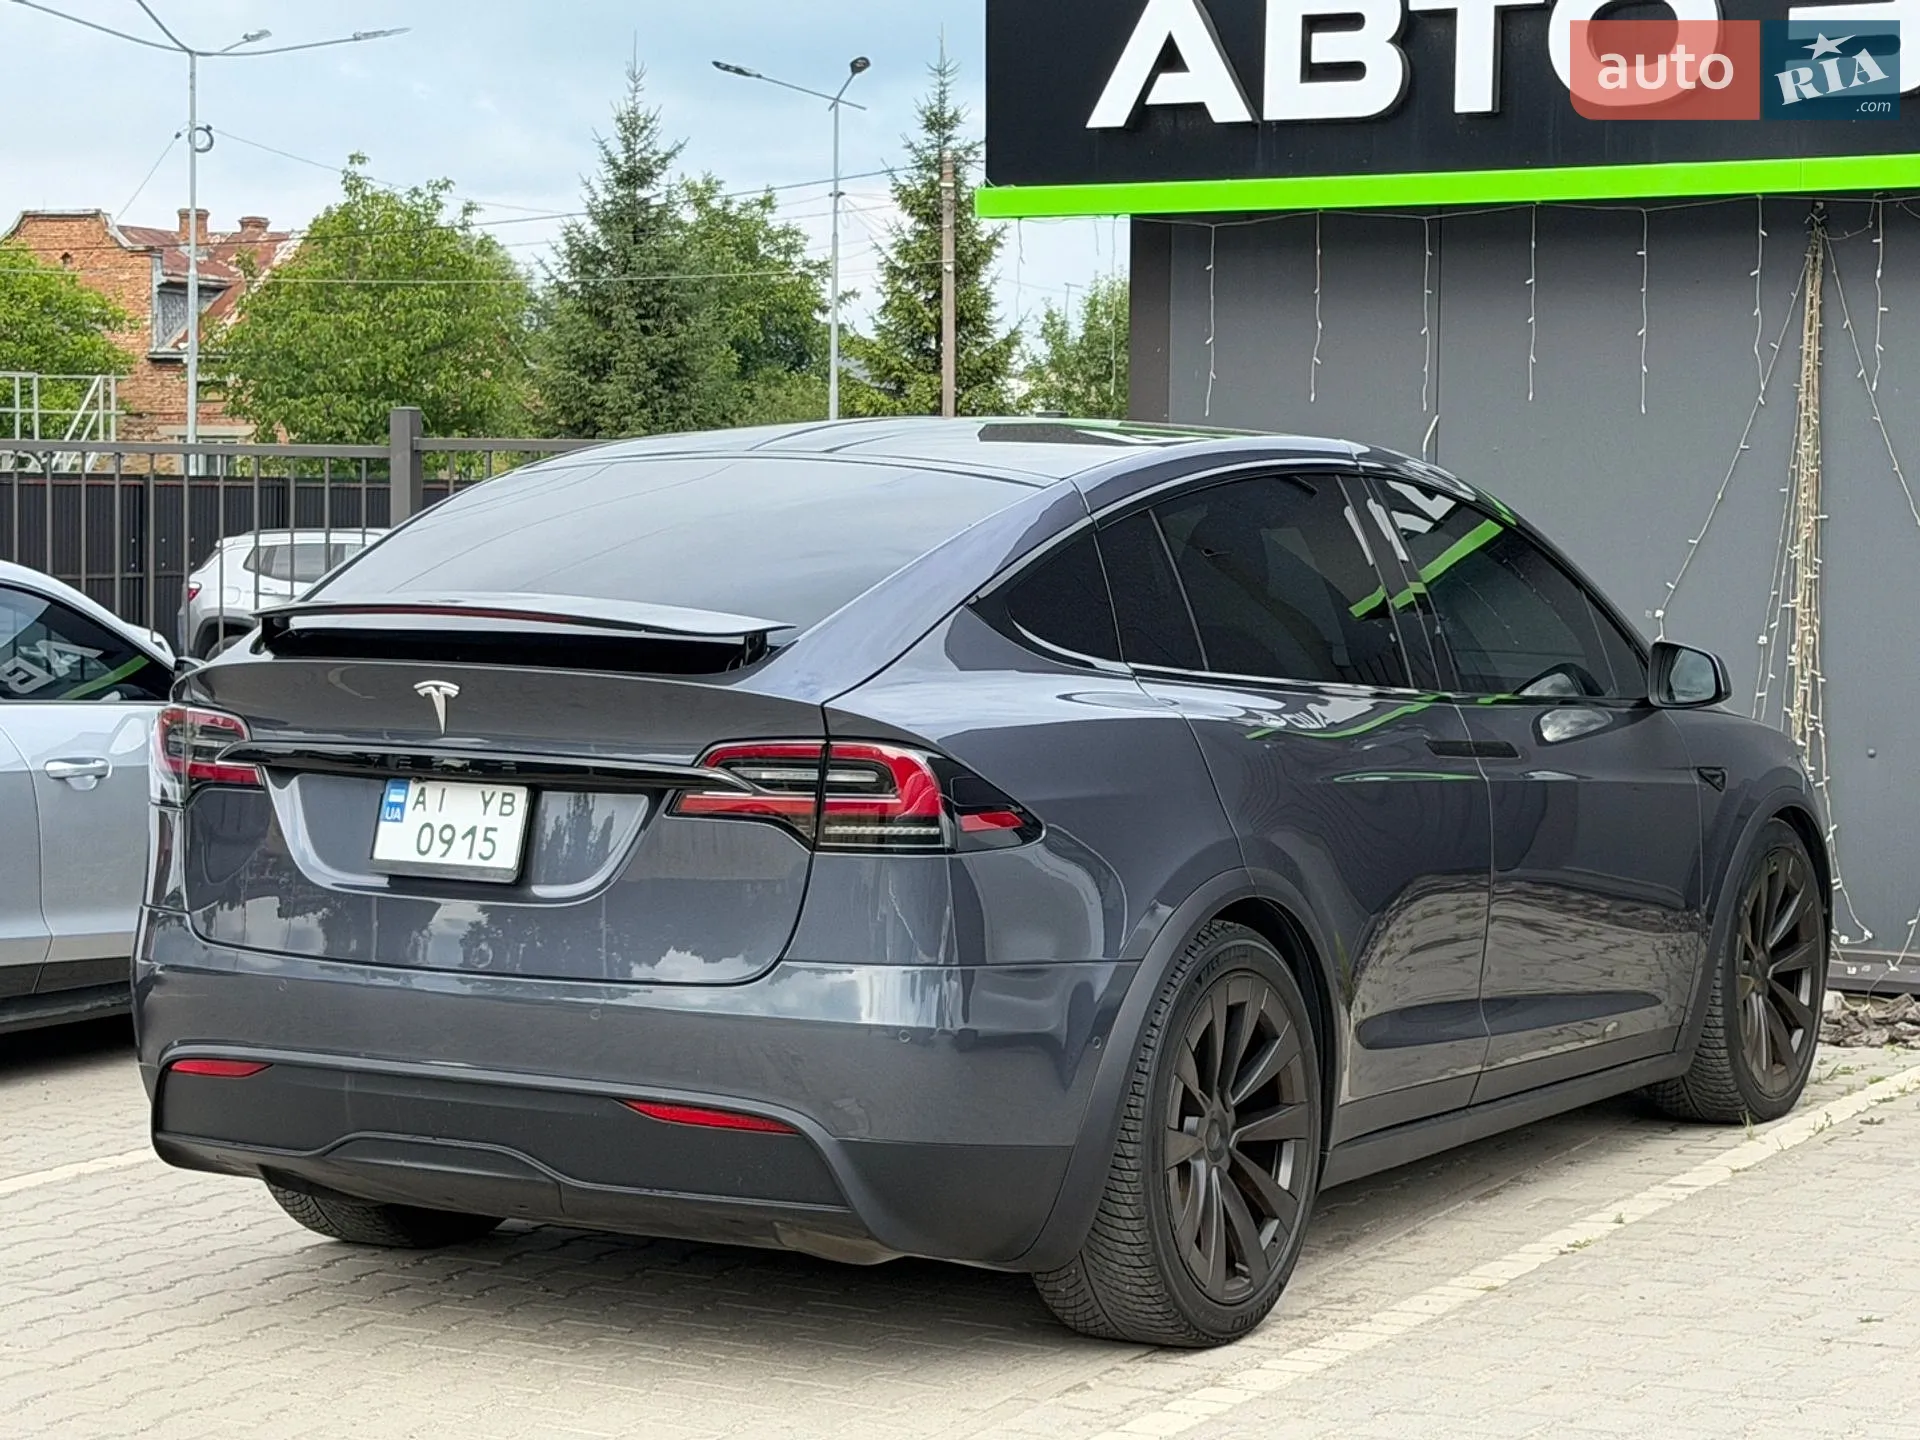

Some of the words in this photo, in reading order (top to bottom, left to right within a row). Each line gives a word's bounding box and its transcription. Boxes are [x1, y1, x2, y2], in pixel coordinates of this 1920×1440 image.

[1085, 0, 1721, 128] АВТО
[384, 806, 402, 820] UA
[416, 822, 498, 861] 0915
